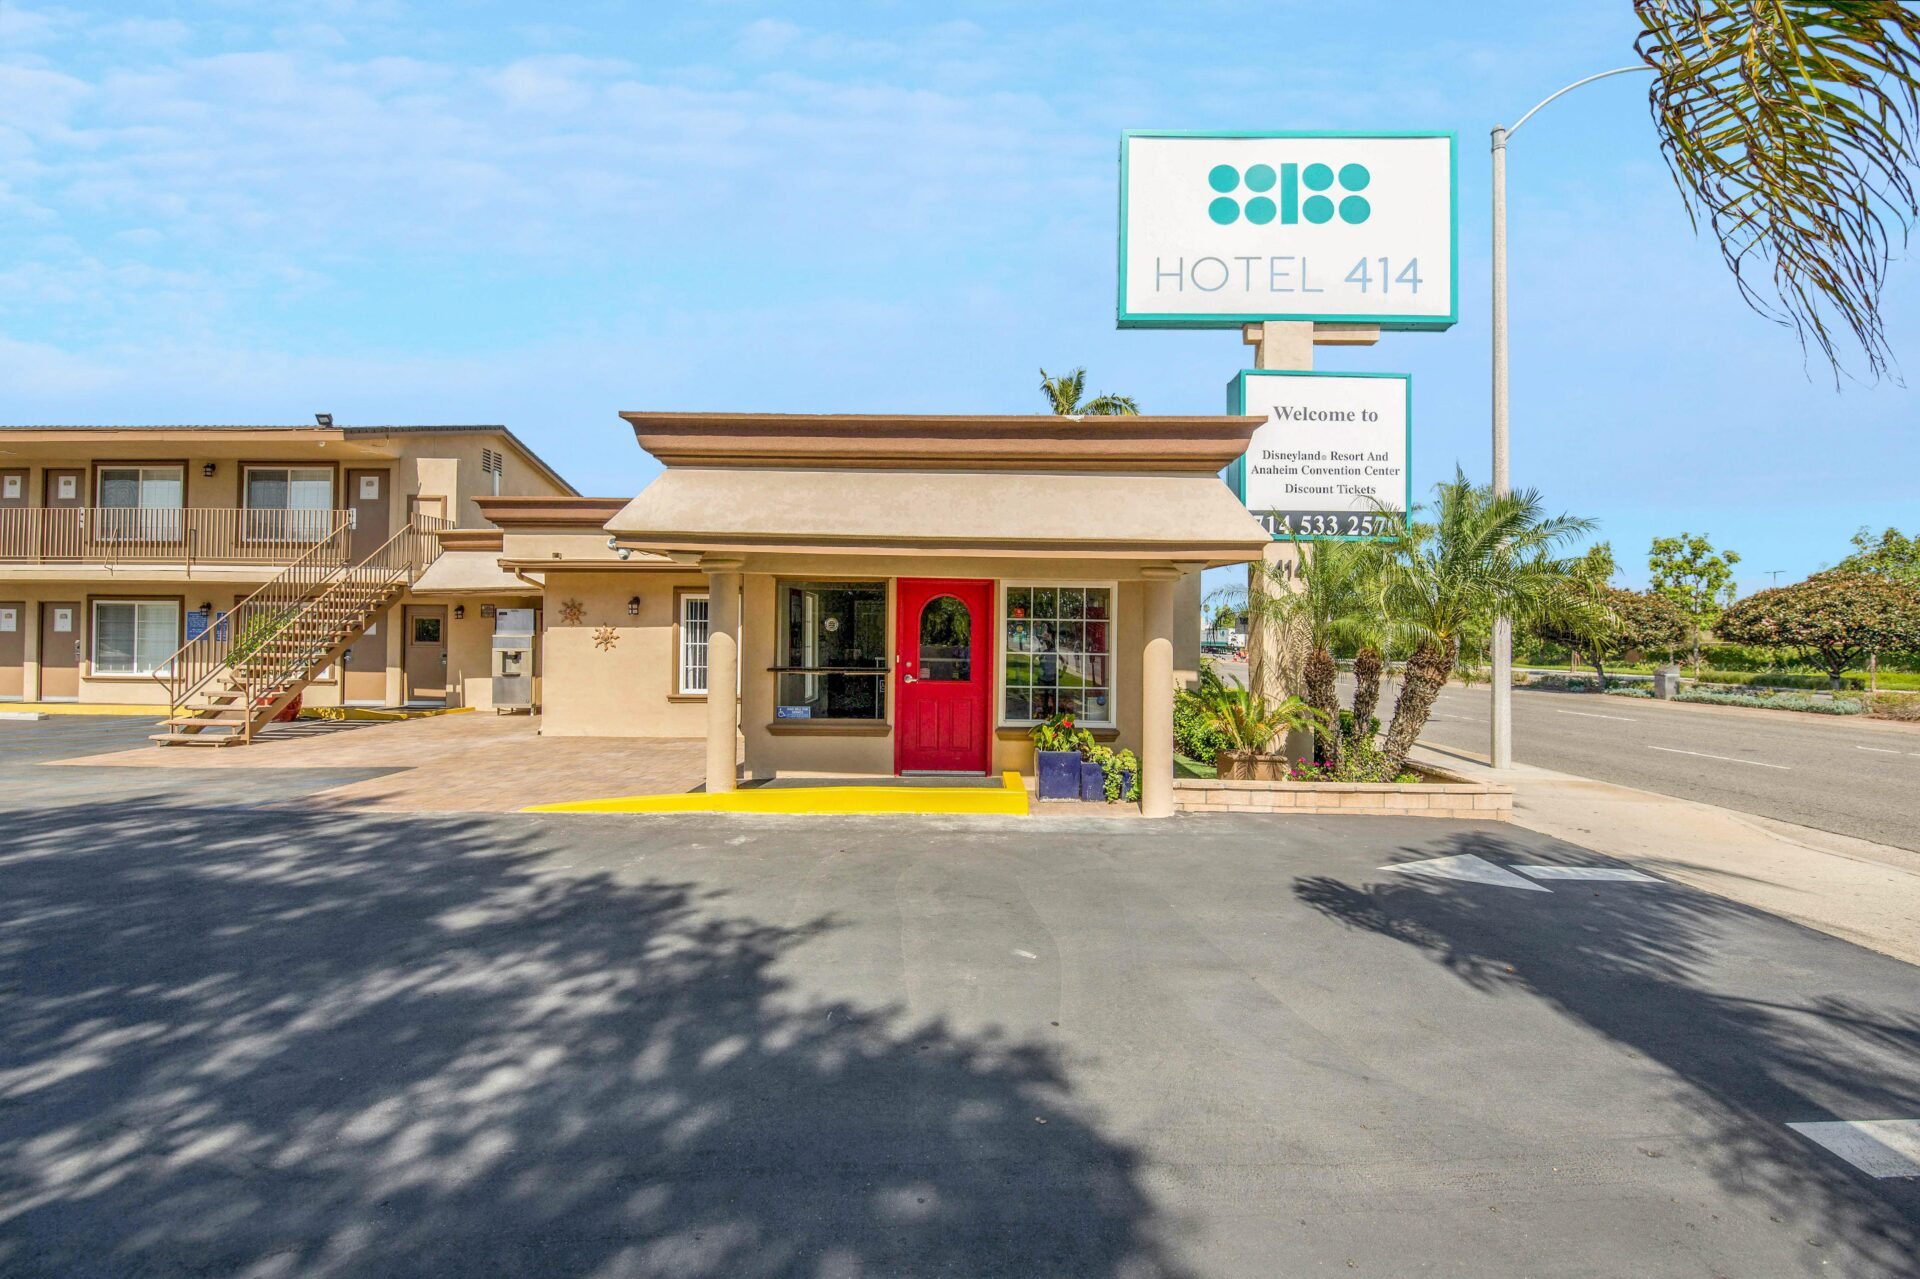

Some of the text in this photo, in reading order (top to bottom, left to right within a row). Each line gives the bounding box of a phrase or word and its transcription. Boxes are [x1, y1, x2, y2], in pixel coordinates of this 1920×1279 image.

[1156, 256, 1423, 294] HOTEL 414
[1273, 406, 1379, 422] Welcome to
[1330, 451, 1364, 461] Resort
[1367, 451, 1389, 461] And
[1251, 464, 1401, 476] Anaheim Convention Center
[1285, 483, 1376, 495] Discount Tickets
[1253, 515, 1291, 535] 714
[1300, 515, 1338, 535] 533
